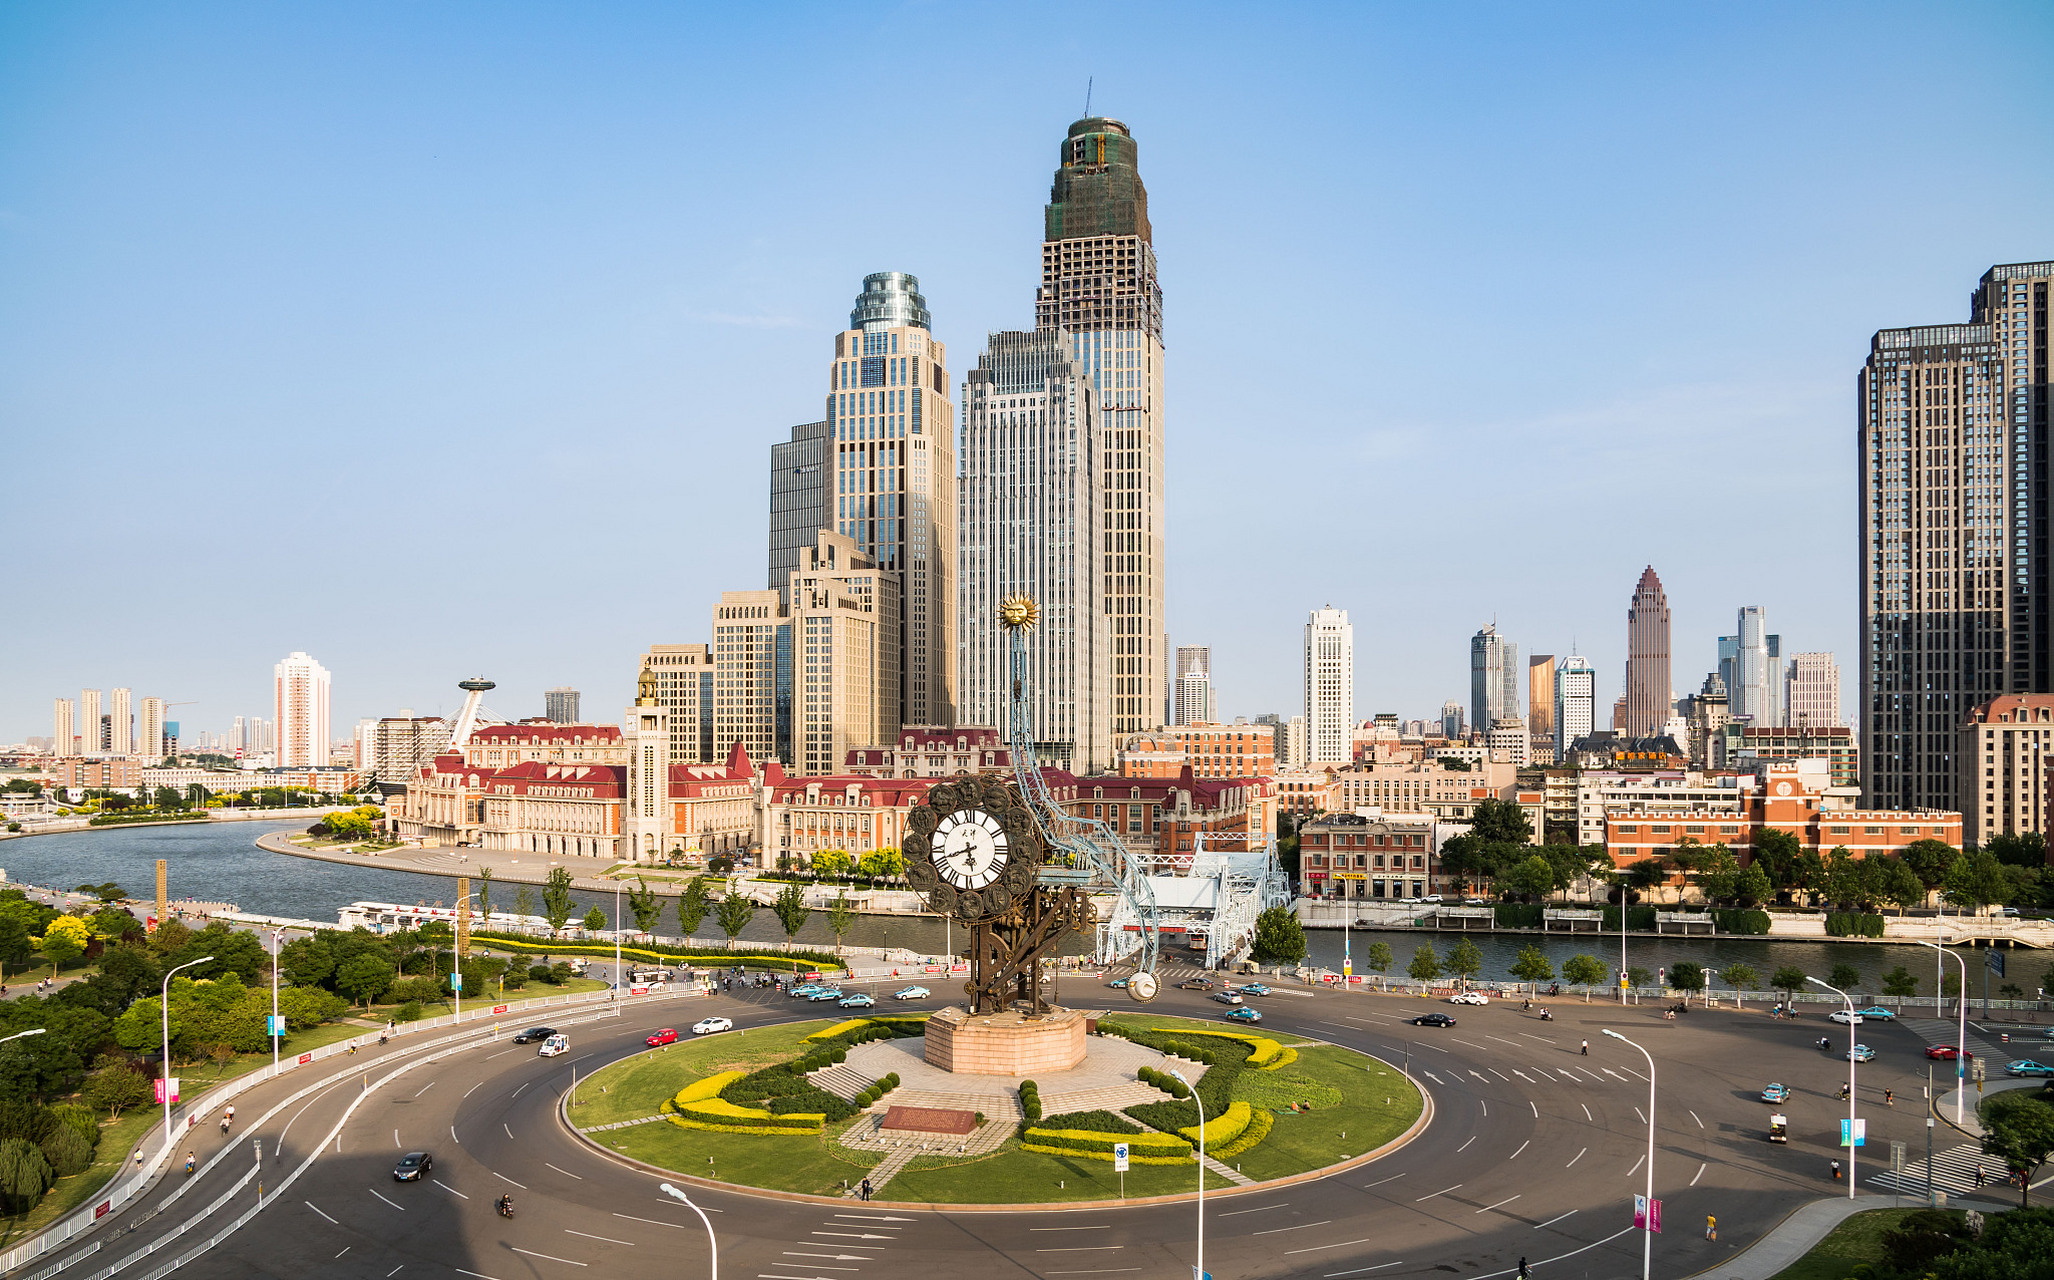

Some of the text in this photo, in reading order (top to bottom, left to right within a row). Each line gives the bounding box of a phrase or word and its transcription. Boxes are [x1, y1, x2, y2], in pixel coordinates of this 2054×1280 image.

[963, 809, 975, 823] XII
[981, 814, 989, 827] I
[990, 828, 1003, 838] II
[994, 845, 1008, 855] III
